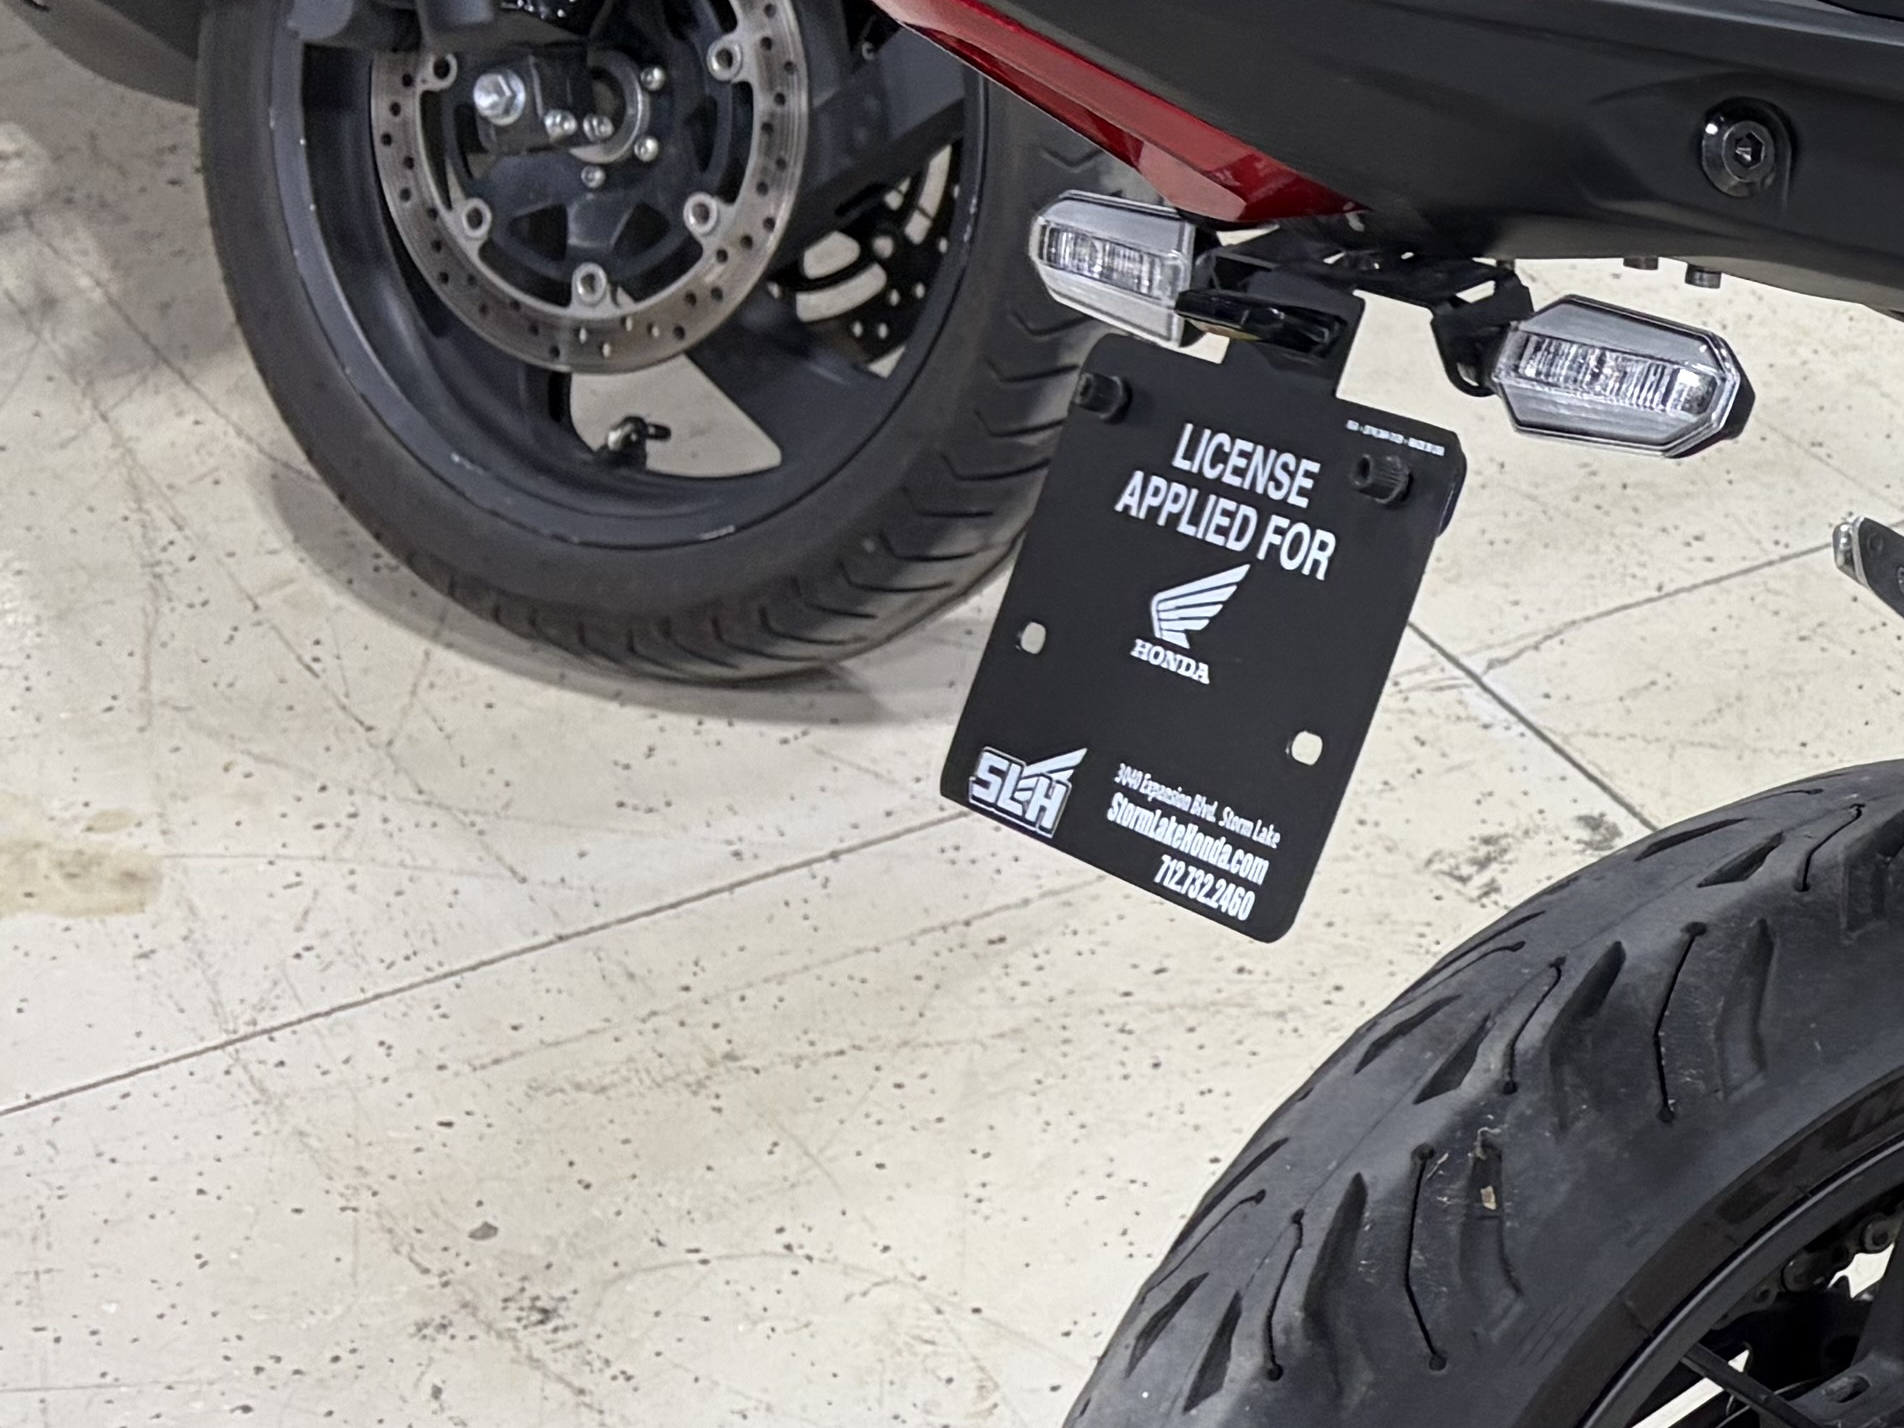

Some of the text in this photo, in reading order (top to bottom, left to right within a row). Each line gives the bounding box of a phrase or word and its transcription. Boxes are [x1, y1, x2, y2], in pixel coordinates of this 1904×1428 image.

[1172, 422, 1321, 509] LICENSE
[1114, 470, 1336, 581] APPLIED FOR
[1130, 638, 1210, 685] HONDA
[969, 749, 1070, 835] SLH
[1140, 773, 1191, 813] Expansion
[1190, 794, 1217, 823] Blvd.
[1219, 806, 1254, 838] Storm
[1253, 819, 1282, 849] Lake
[1107, 792, 1270, 886] StormLakeHonda.com
[1153, 854, 1256, 922] 712.732.2460
